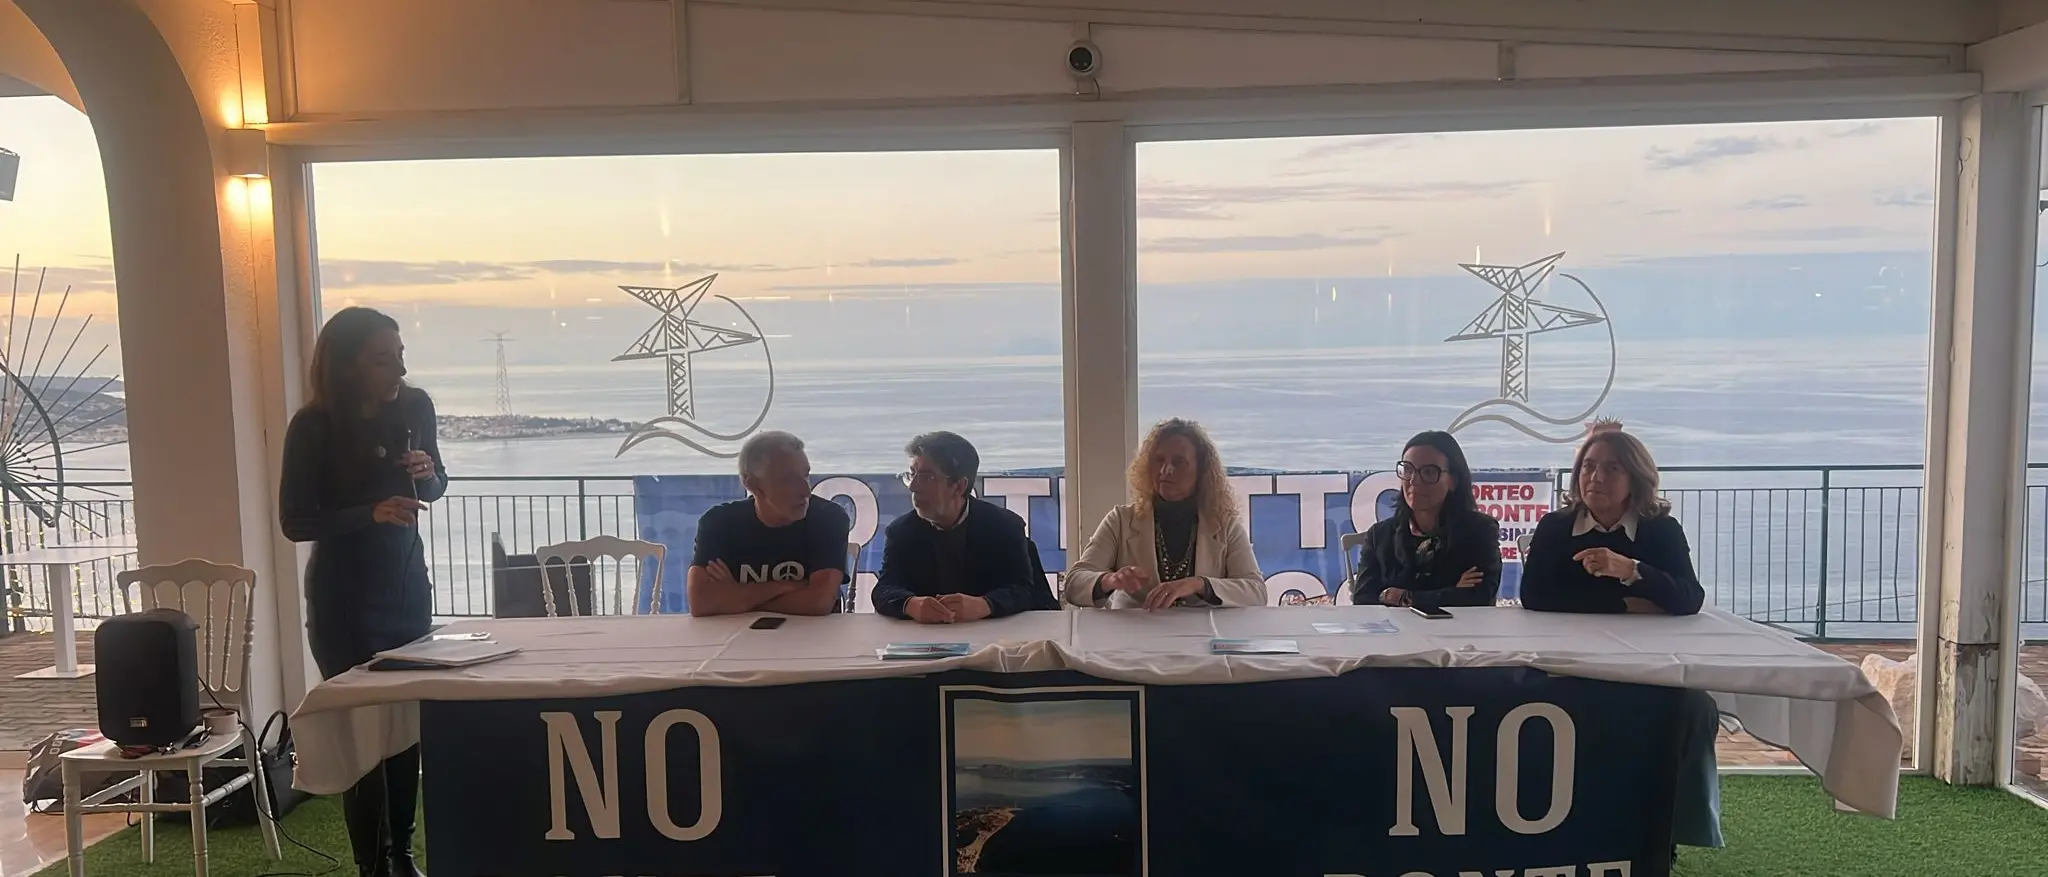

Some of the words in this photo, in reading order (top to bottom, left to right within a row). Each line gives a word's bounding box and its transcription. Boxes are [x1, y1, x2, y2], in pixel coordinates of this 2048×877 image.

[1471, 484, 1534, 501] ORTEO
[739, 560, 805, 585] NO
[539, 708, 723, 841] NO
[1388, 702, 1576, 836] NO
